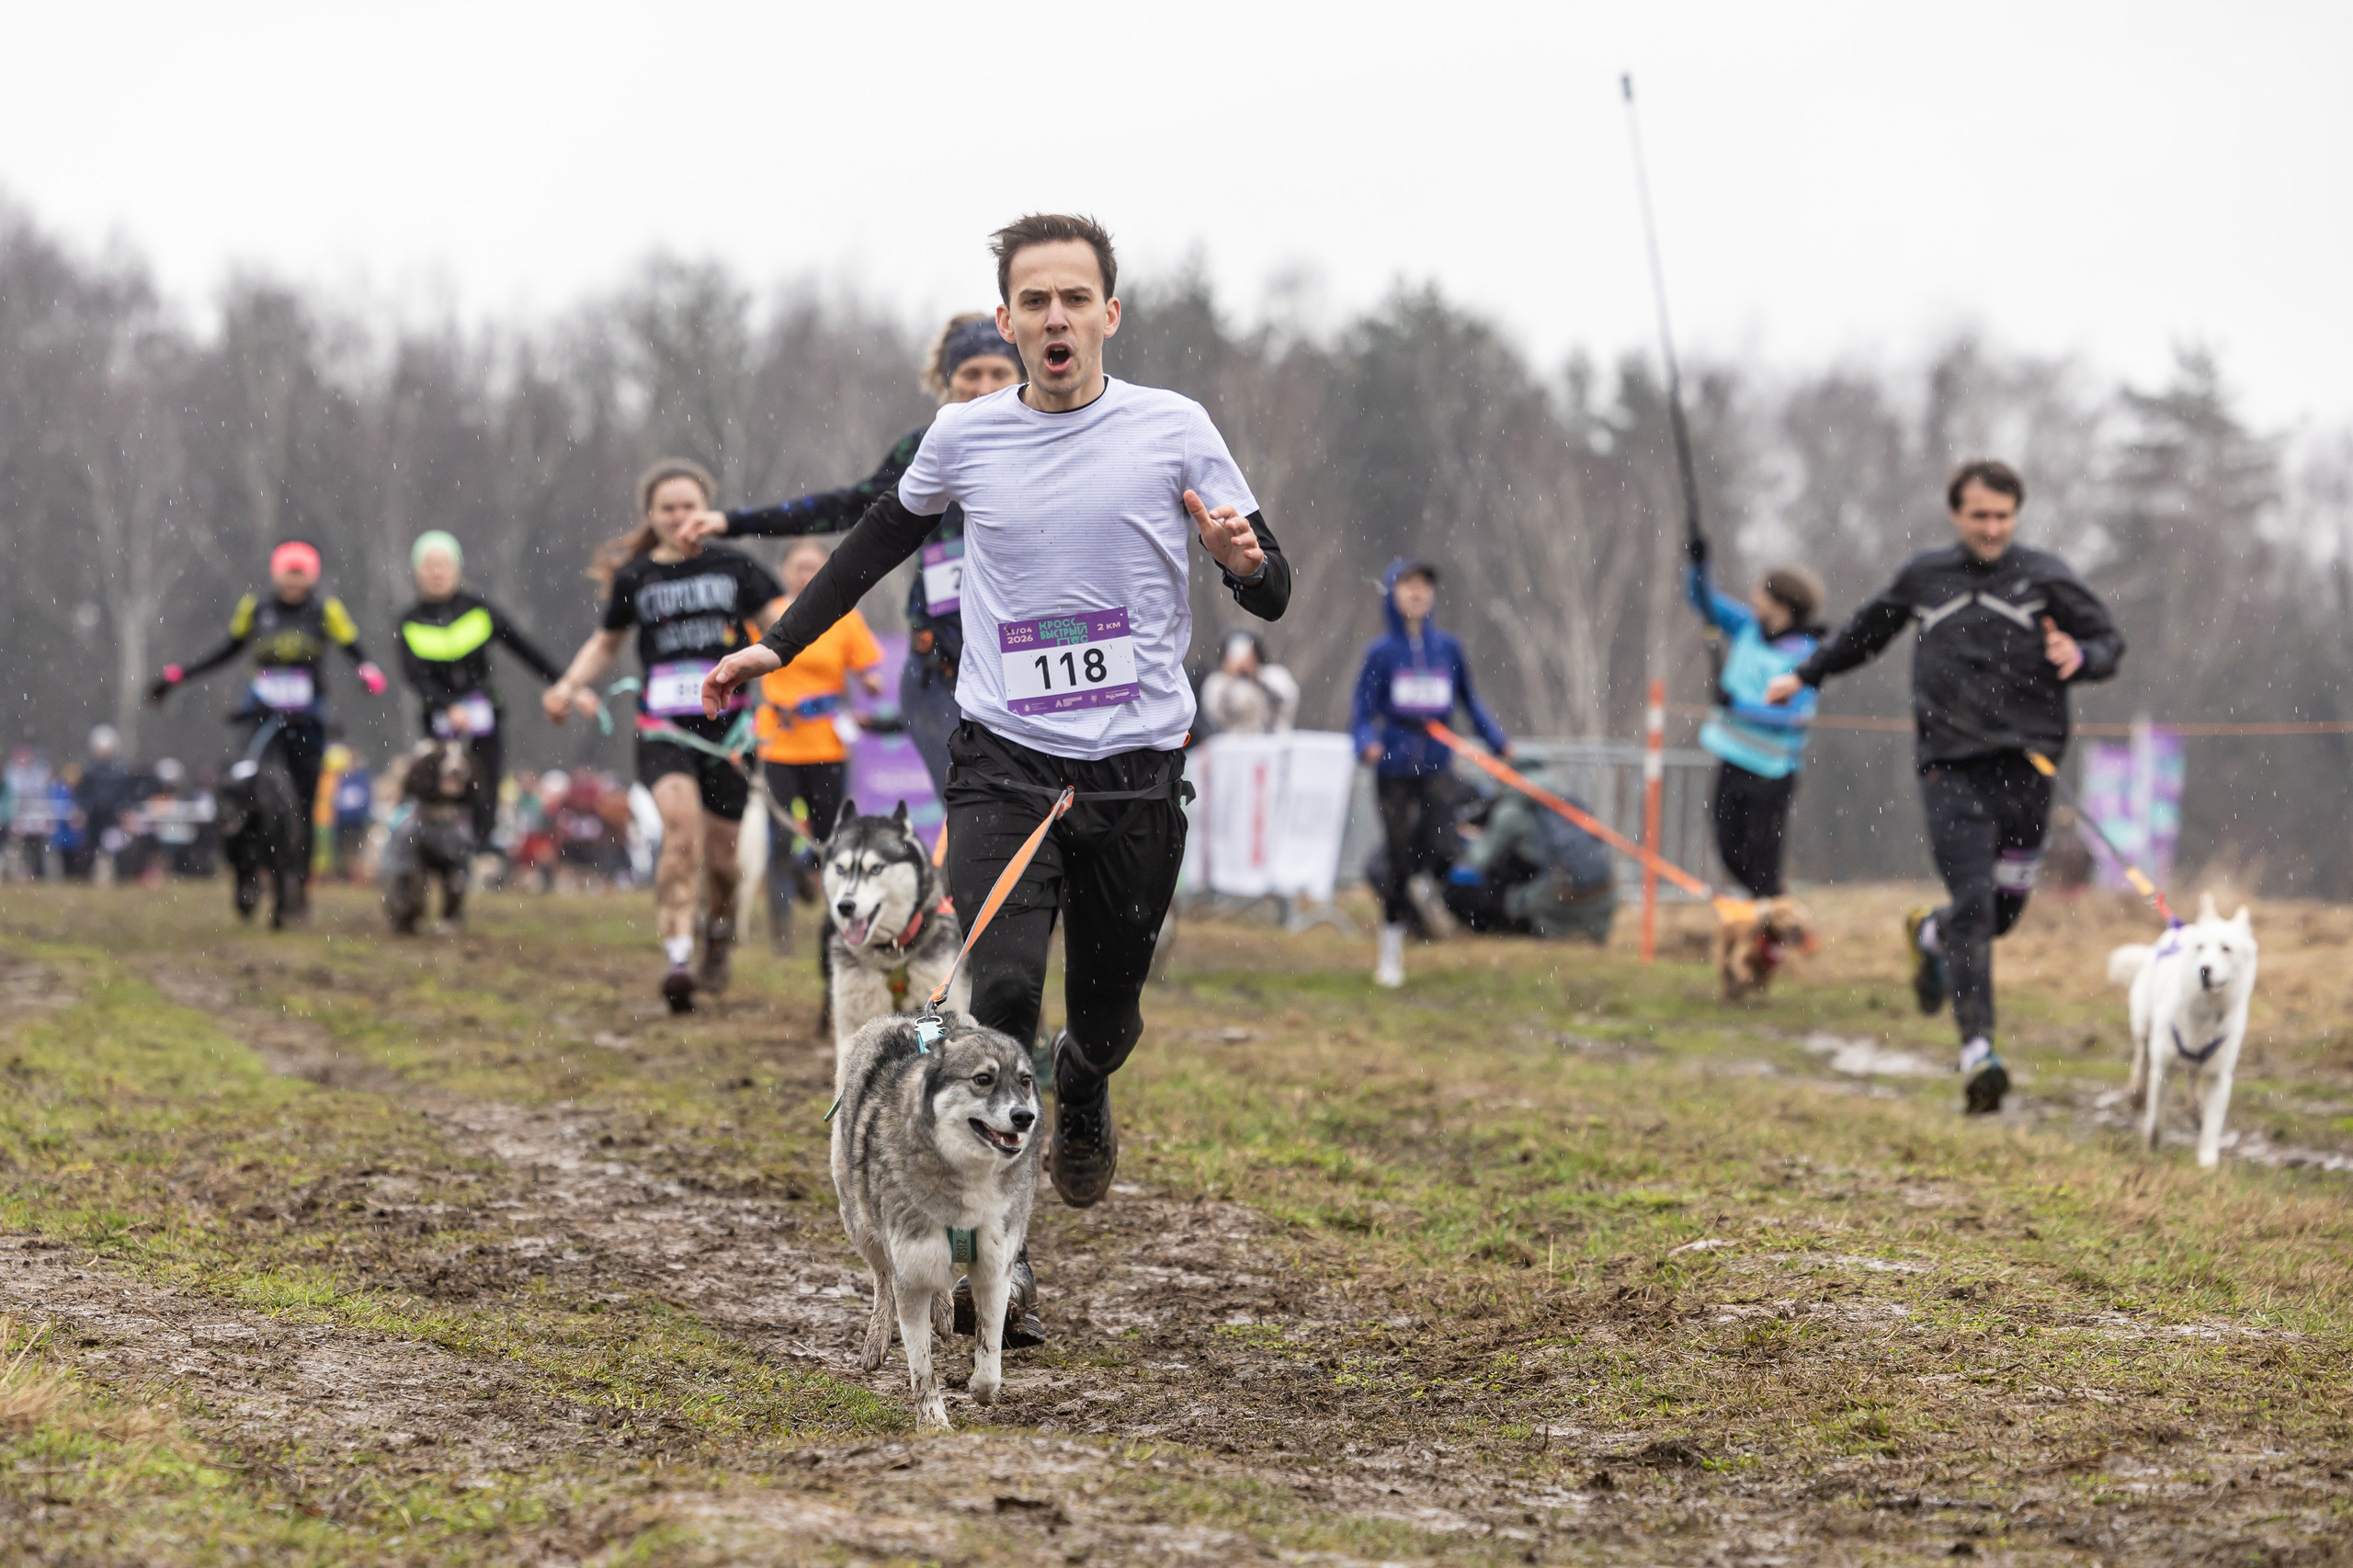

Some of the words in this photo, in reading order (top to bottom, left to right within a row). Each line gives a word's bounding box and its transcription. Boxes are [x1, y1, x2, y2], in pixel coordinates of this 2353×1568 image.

[1039, 618, 1076, 631] КРОСС
[1097, 623, 1104, 631] 2
[1006, 634, 1034, 644] 2026
[1035, 648, 1107, 690] 118
